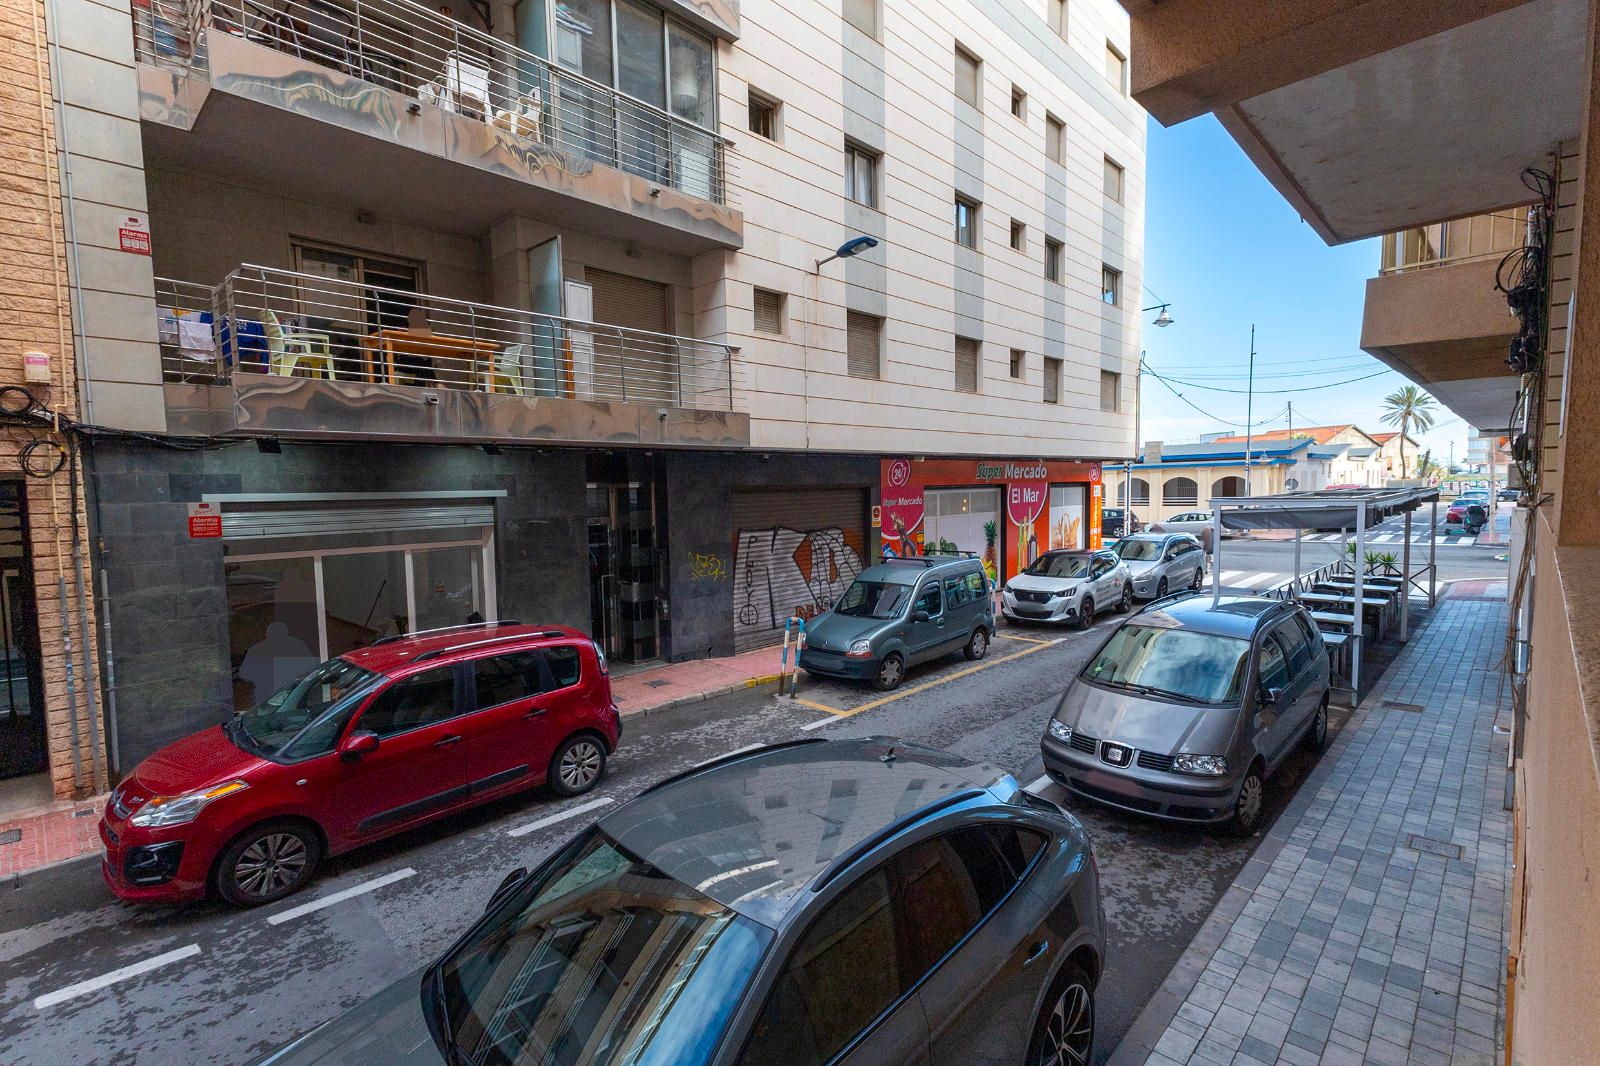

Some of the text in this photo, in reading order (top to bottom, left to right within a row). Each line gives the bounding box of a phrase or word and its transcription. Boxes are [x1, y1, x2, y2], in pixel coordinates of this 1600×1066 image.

[121, 229, 148, 238] Alarma
[976, 463, 1047, 480] Super Mercado
[898, 496, 922, 506] Mercado
[1011, 488, 1040, 504] El Mar
